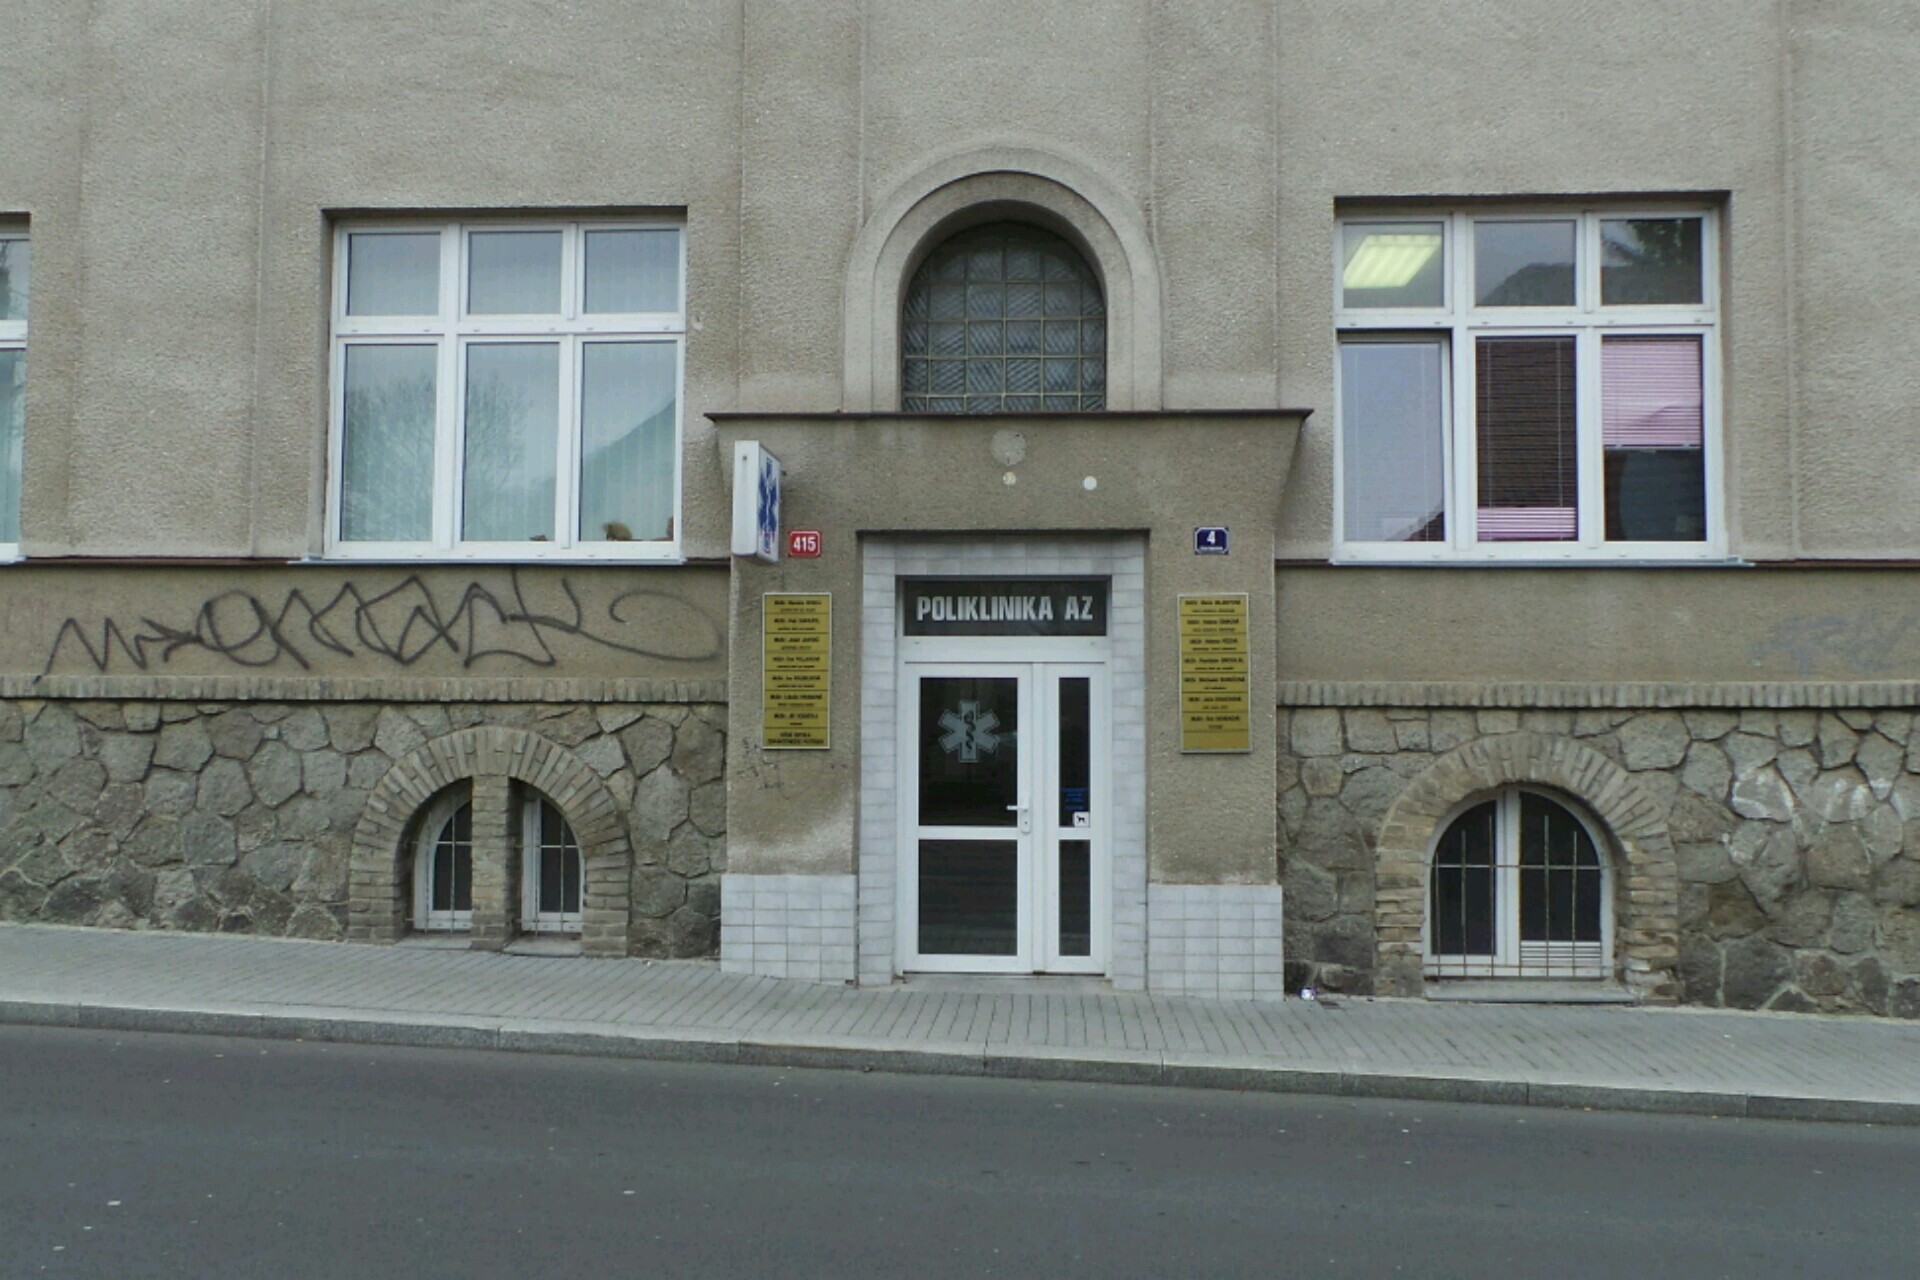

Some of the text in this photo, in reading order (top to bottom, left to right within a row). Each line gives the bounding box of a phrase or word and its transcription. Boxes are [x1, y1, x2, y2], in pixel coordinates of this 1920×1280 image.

[793, 536, 817, 552] 415
[1206, 530, 1216, 545] 4
[916, 596, 1093, 621] POLIKLINIKA AZ
